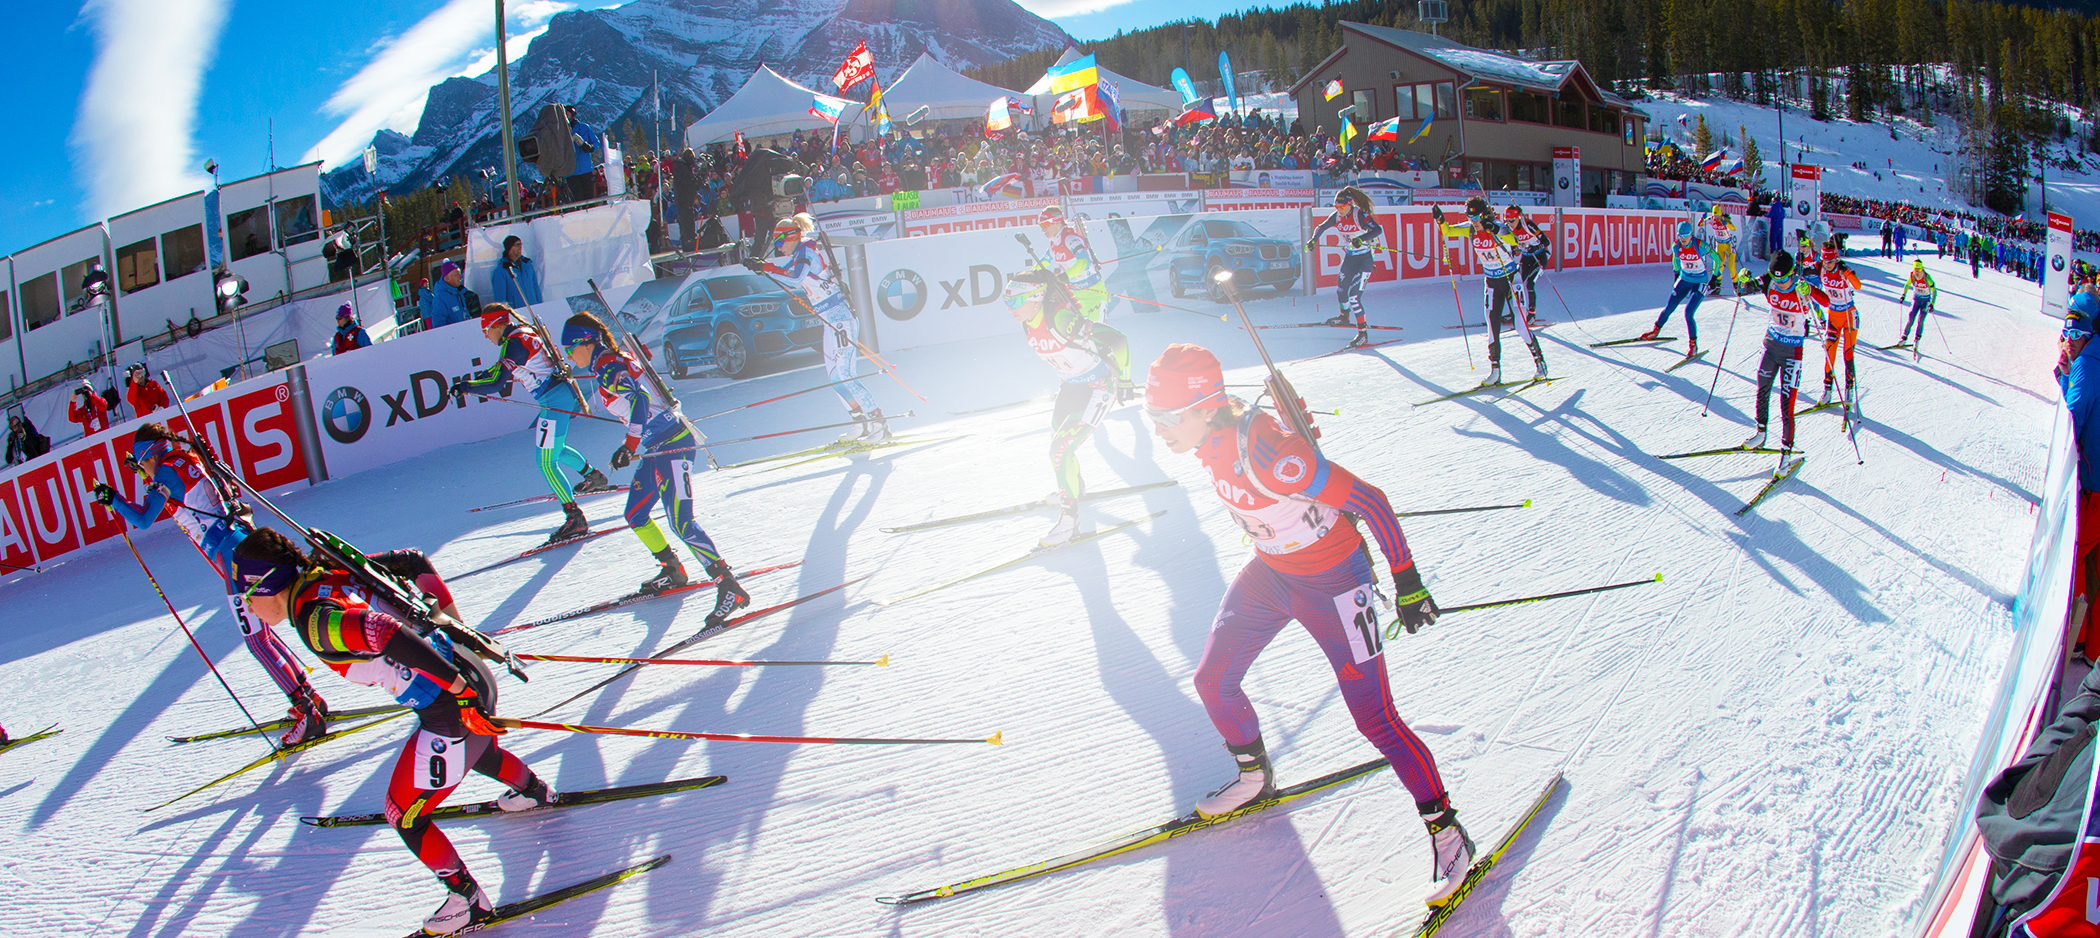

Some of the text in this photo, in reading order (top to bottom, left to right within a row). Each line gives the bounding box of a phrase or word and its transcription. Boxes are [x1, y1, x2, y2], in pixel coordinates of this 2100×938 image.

[912, 197, 1060, 218] BAUHAUS BAUHAUS BAUHAUS
[825, 215, 888, 230] BMW BMW BMW
[1319, 221, 1553, 276] BAUH
[1565, 222, 1674, 259] BAUHAU
[1482, 251, 1494, 261] 14
[820, 281, 830, 292] 10
[1829, 289, 1838, 298] 18
[1777, 313, 1789, 326] 15
[1782, 358, 1796, 388] JAPAN
[380, 357, 514, 428] xDriv
[1090, 401, 1108, 427] 11
[540, 427, 548, 448] 7
[682, 471, 692, 499] 8
[1301, 504, 1324, 530] 12
[618, 593, 656, 606] ROSSIGNOL
[714, 590, 736, 618] ROSSI
[236, 606, 251, 635] 5
[1353, 605, 1383, 657] 12
[684, 624, 725, 645] ROSSIGNOL
[648, 732, 688, 740] LEKI
[429, 755, 447, 788] 9
[1169, 799, 1280, 838] FISCHER
[1426, 859, 1494, 938] FISCHER
